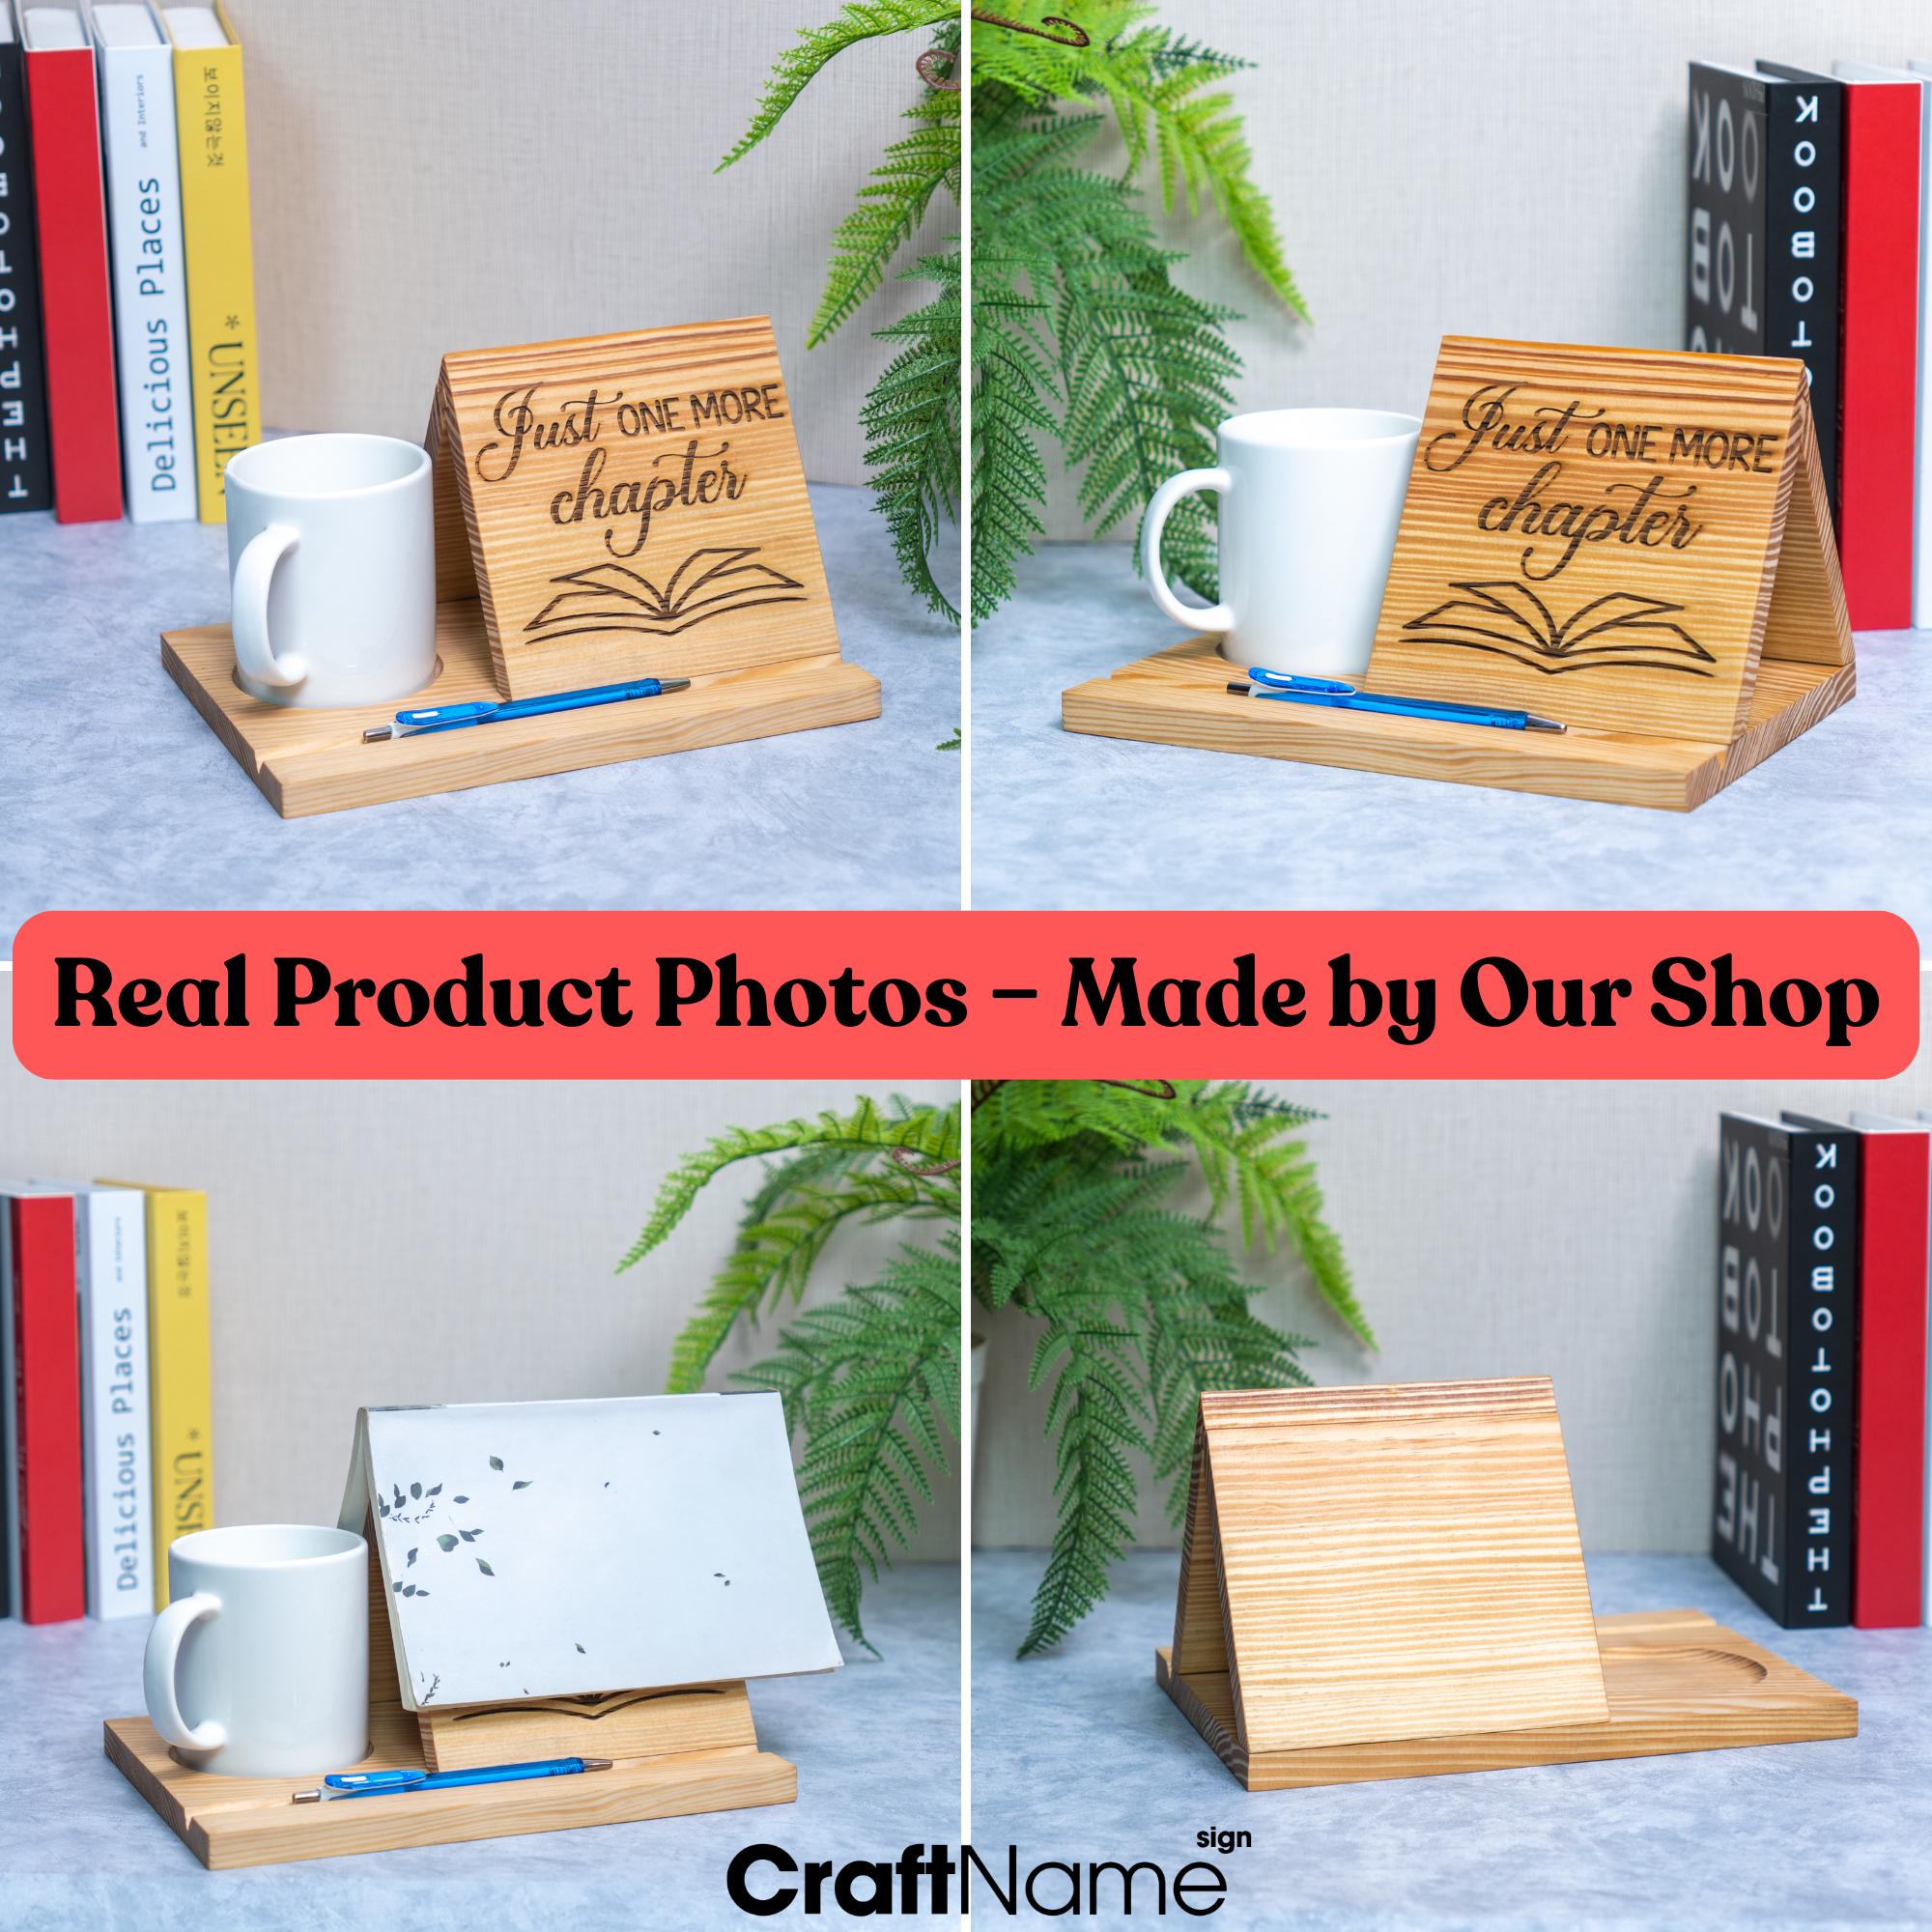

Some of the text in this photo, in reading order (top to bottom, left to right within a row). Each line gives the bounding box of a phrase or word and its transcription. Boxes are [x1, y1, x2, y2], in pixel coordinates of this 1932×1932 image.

[135, 74, 176, 492] Delicious Places and Interiors
[208, 342, 249, 496] UNSEE
[476, 382, 784, 482] Just ONE MORE
[1424, 382, 1779, 473] Just ONE MORE
[550, 440, 750, 558] chapter
[1477, 460, 1703, 582] chapter
[110, 1307, 140, 1592] Delicious Places
